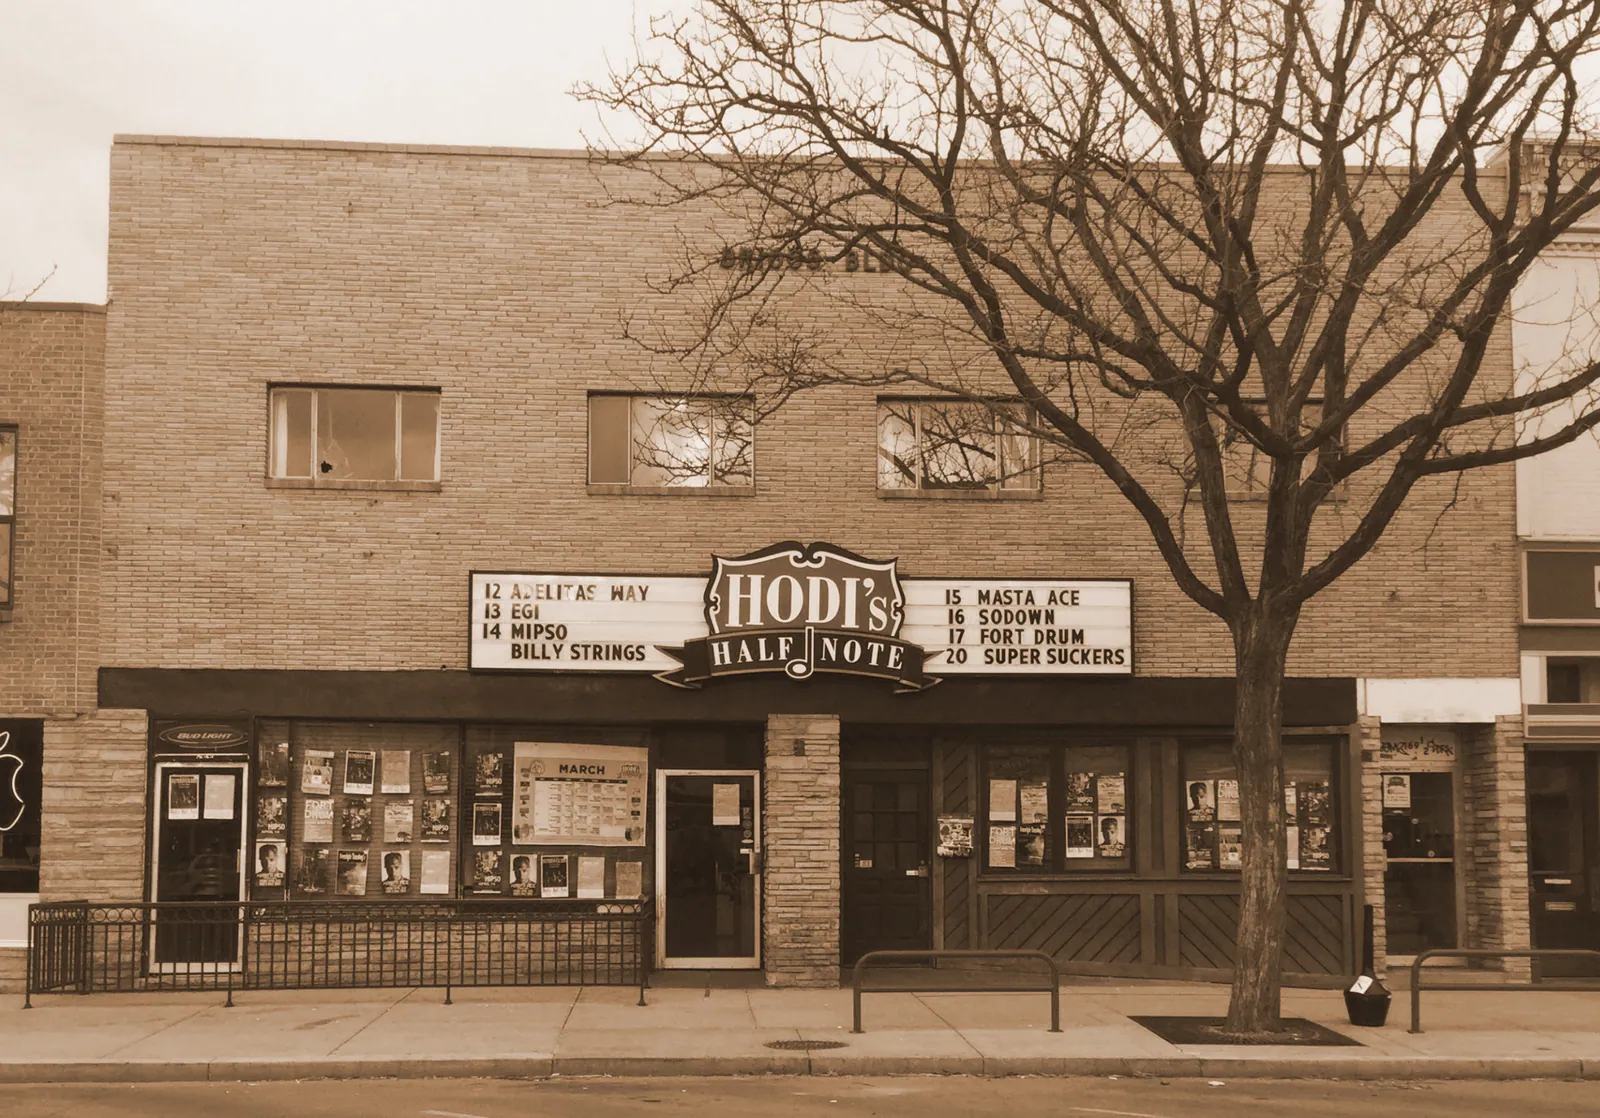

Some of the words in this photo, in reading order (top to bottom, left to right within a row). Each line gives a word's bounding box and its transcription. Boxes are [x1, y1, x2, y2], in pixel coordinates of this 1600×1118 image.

[485, 583, 501, 600] 12
[611, 585, 649, 601] WAY
[945, 589, 961, 605] 15
[977, 589, 1035, 605] MASTA
[1047, 590, 1080, 606] ACE
[484, 603, 501, 619] 13
[948, 608, 965, 625] 16
[979, 609, 1055, 625] SODOWN
[482, 623, 501, 639] 14
[511, 624, 568, 640] MIPSO
[949, 628, 965, 644] 17
[980, 628, 1025, 645] FORT
[1034, 629, 1085, 645] DRUM
[511, 644, 563, 660] BILLY
[570, 645, 646, 661] STRINGS
[711, 637, 793, 666] HALF
[820, 637, 904, 670] NOTE
[945, 648, 968, 664] 20
[984, 649, 1041, 665] SUPER
[1046, 649, 1125, 665] SUCKERS
[559, 764, 605, 775] MARCH
[1219, 780, 1239, 790] FOR
[305, 799, 334, 809] FORT
